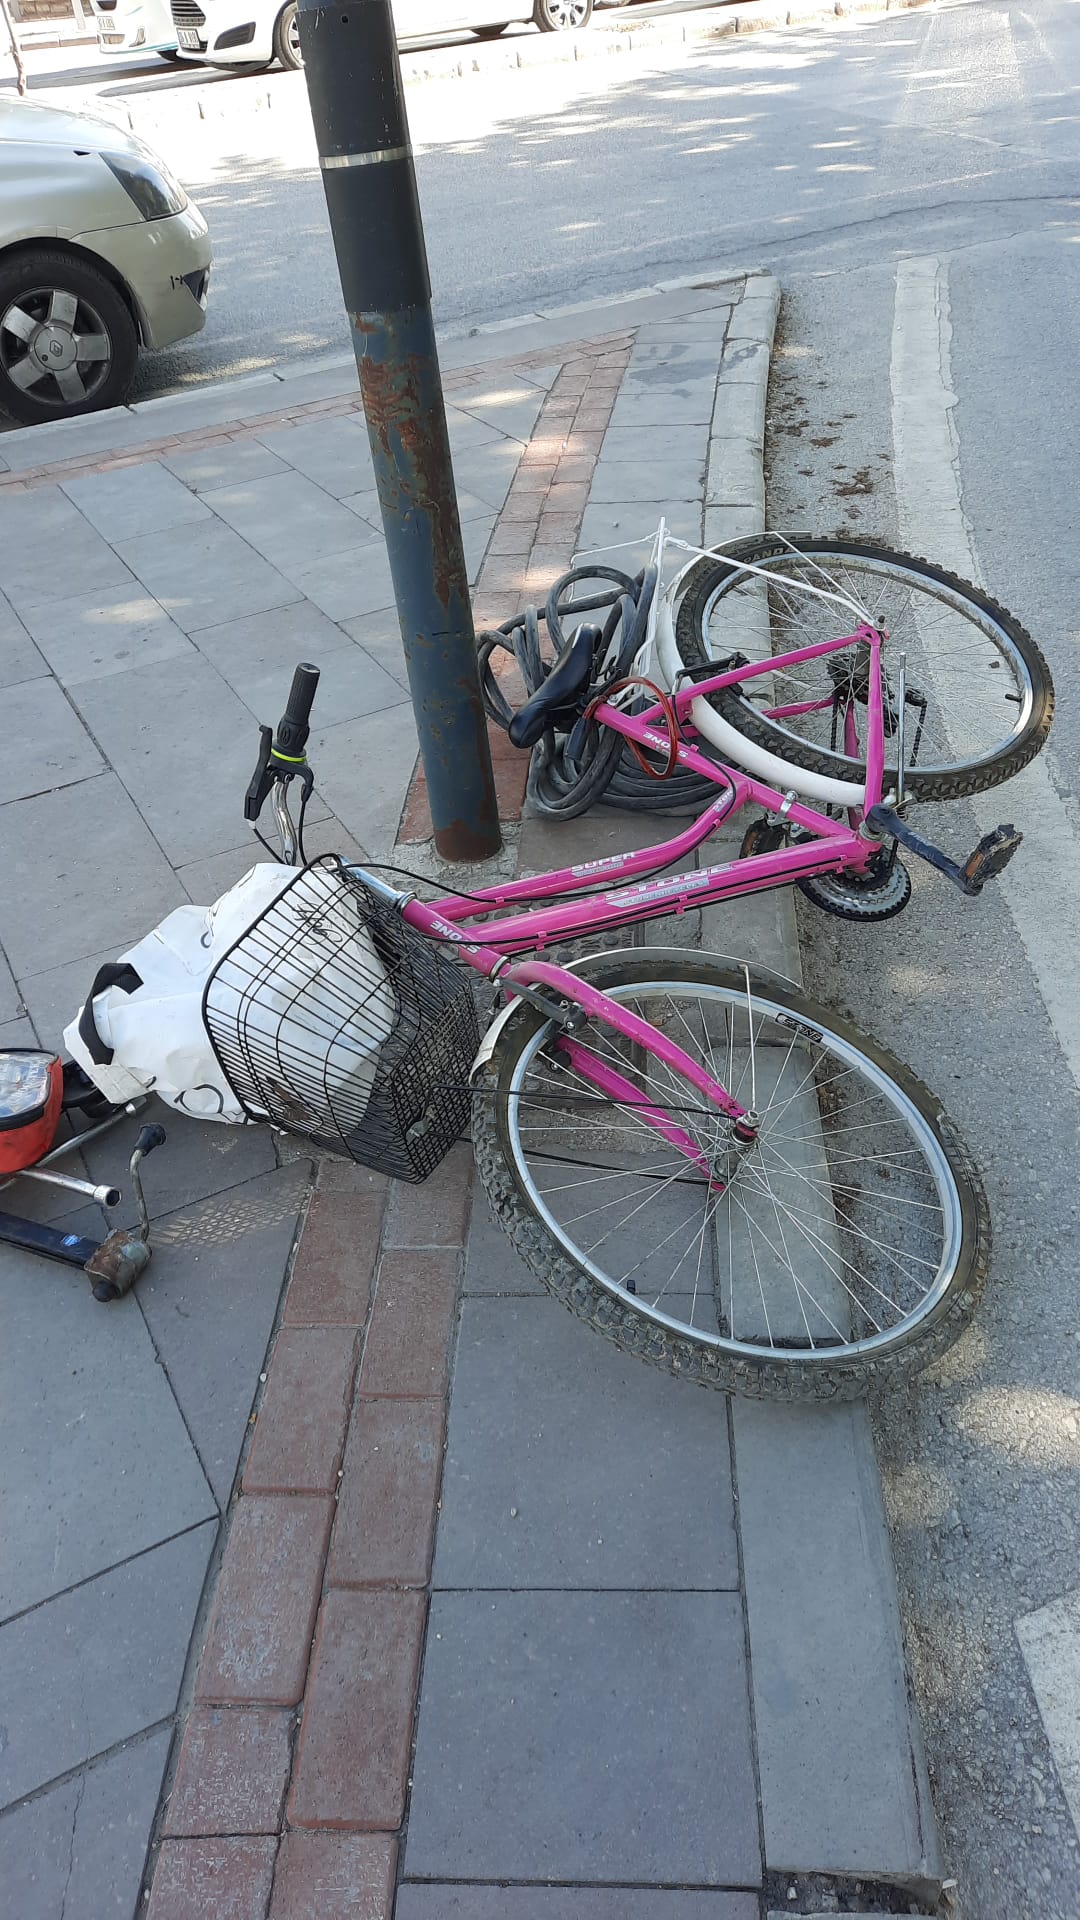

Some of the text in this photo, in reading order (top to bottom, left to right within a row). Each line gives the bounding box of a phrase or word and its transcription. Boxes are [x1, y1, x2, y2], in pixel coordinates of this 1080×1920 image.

[643, 731, 689, 759] SONE
[571, 851, 636, 873] SUPER
[605, 862, 732, 901] STONE
[430, 920, 482, 954] SONE
